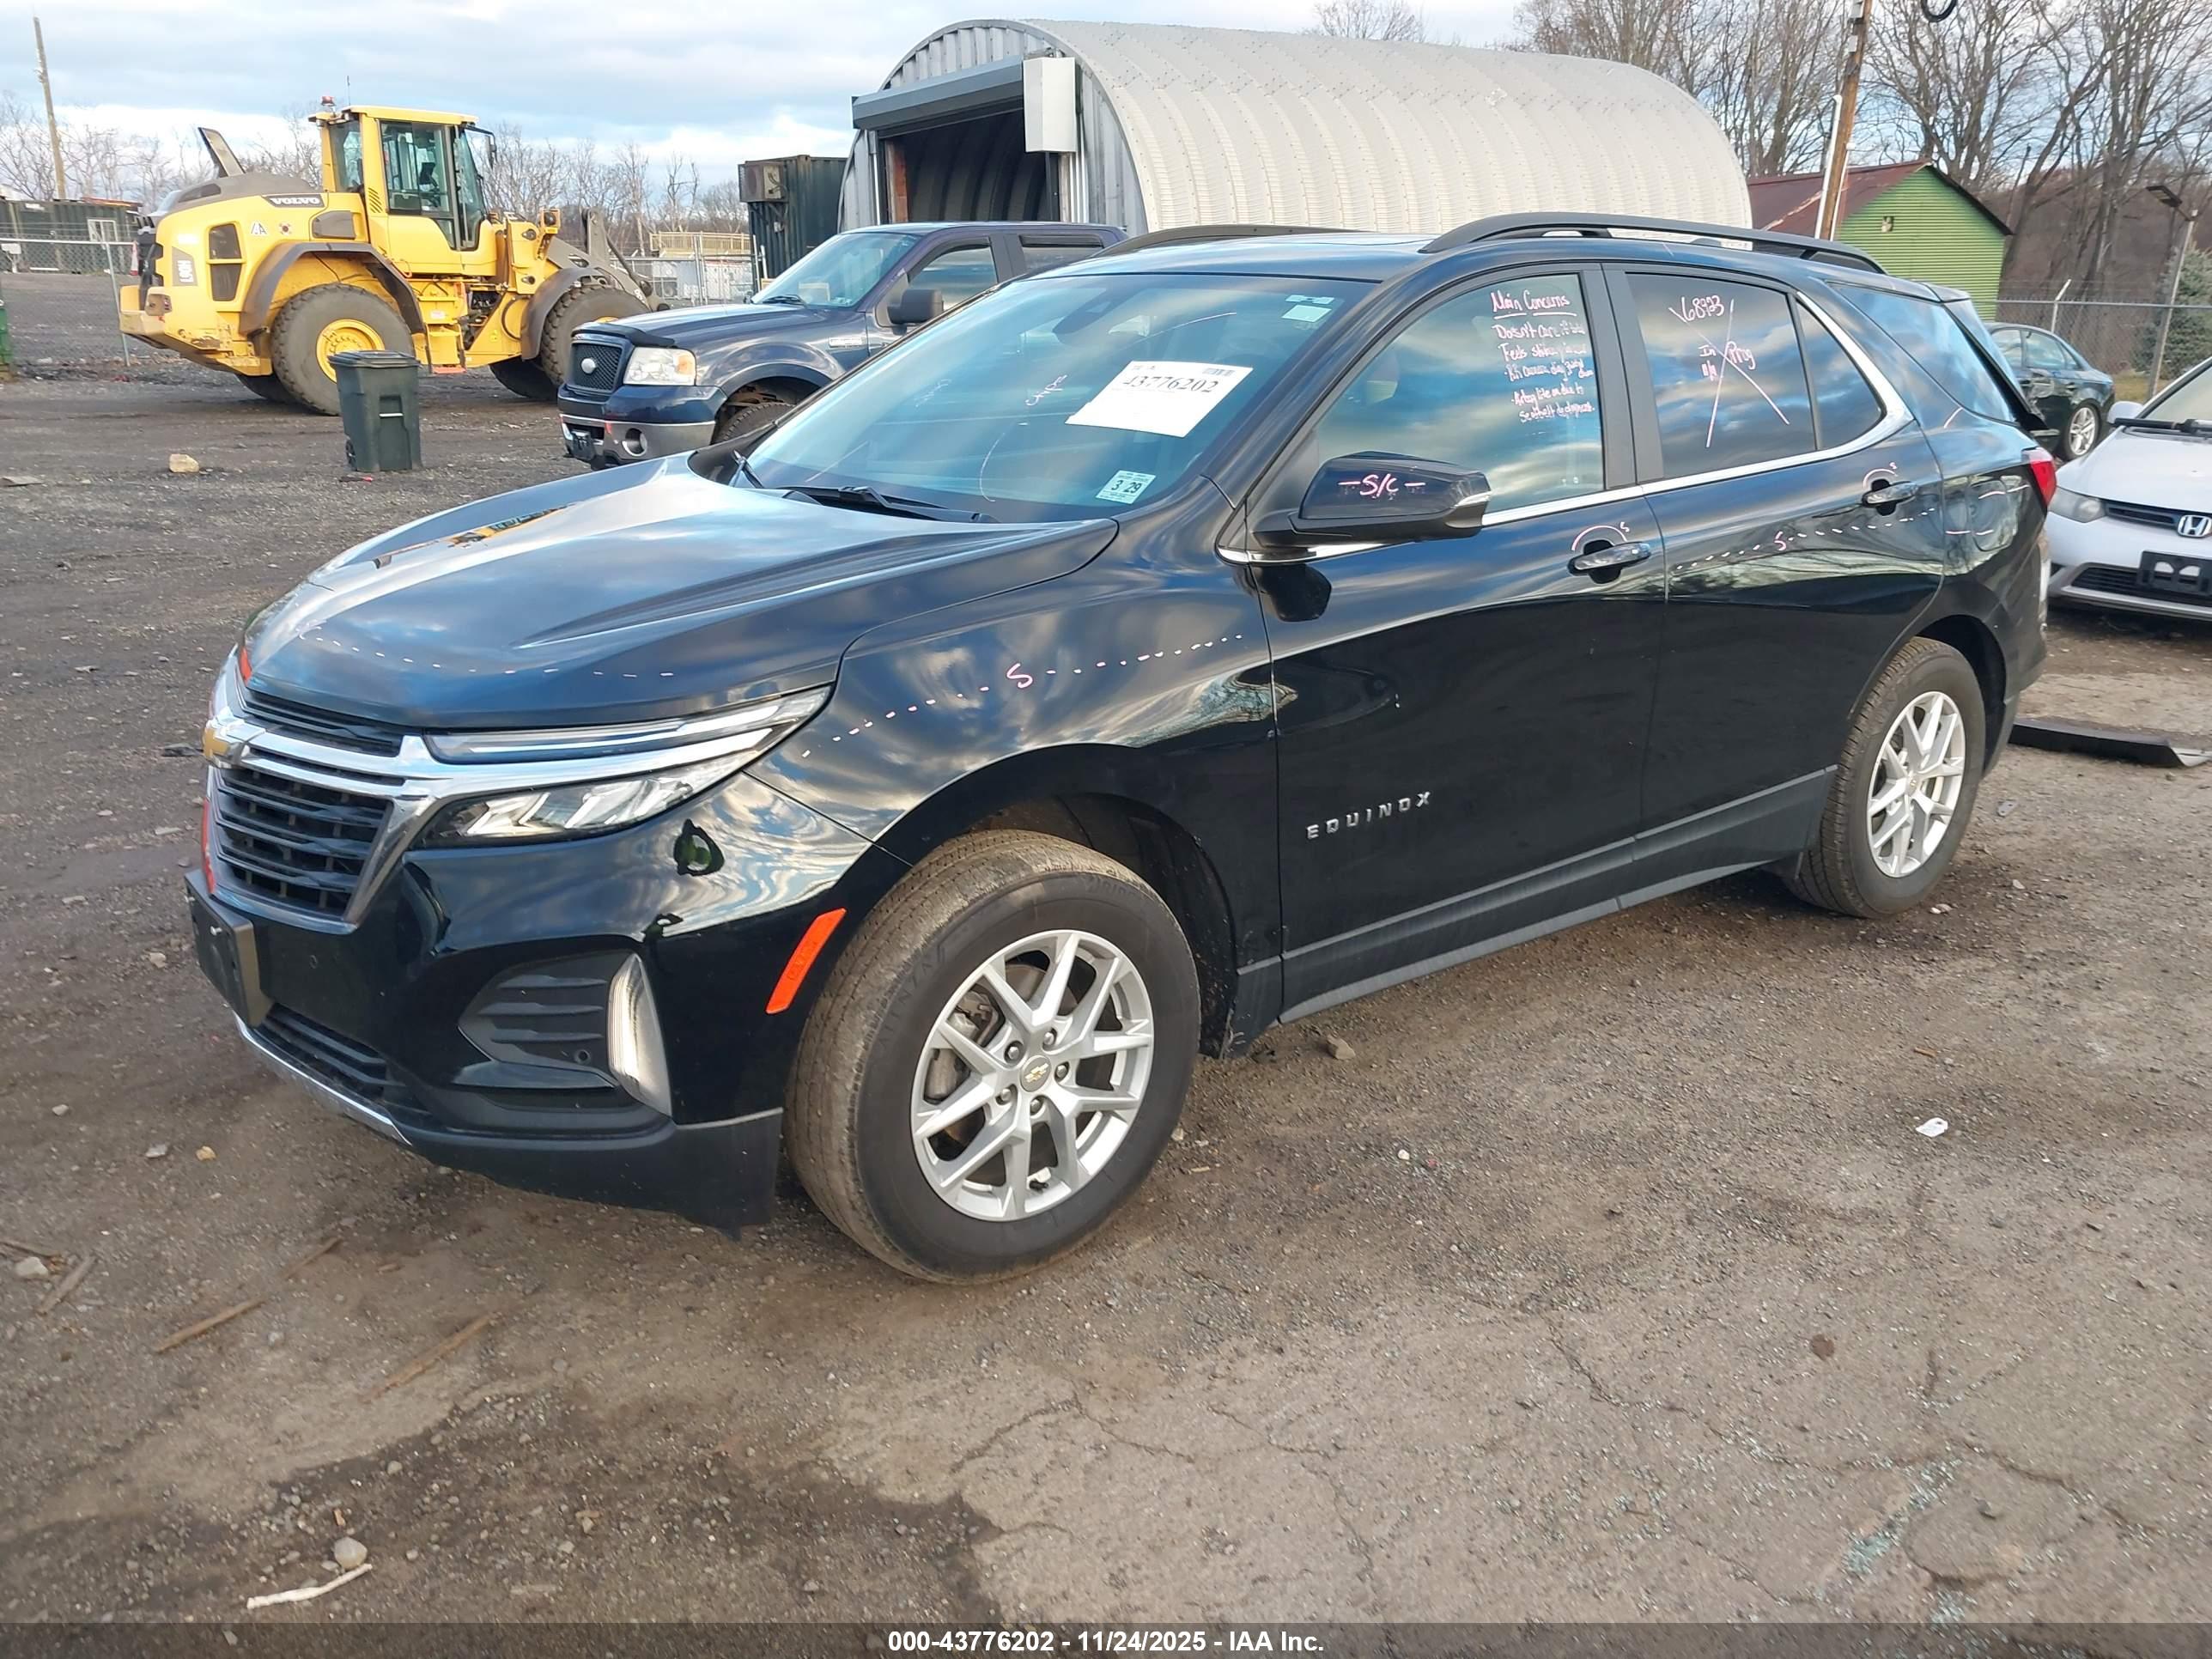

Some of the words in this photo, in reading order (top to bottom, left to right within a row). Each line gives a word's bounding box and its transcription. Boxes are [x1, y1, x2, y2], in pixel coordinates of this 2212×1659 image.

[270, 197, 321, 205] VOLVO
[1111, 480, 1124, 490] 3
[1123, 482, 1142, 493] 29
[1306, 791, 1431, 840] EQUINOX
